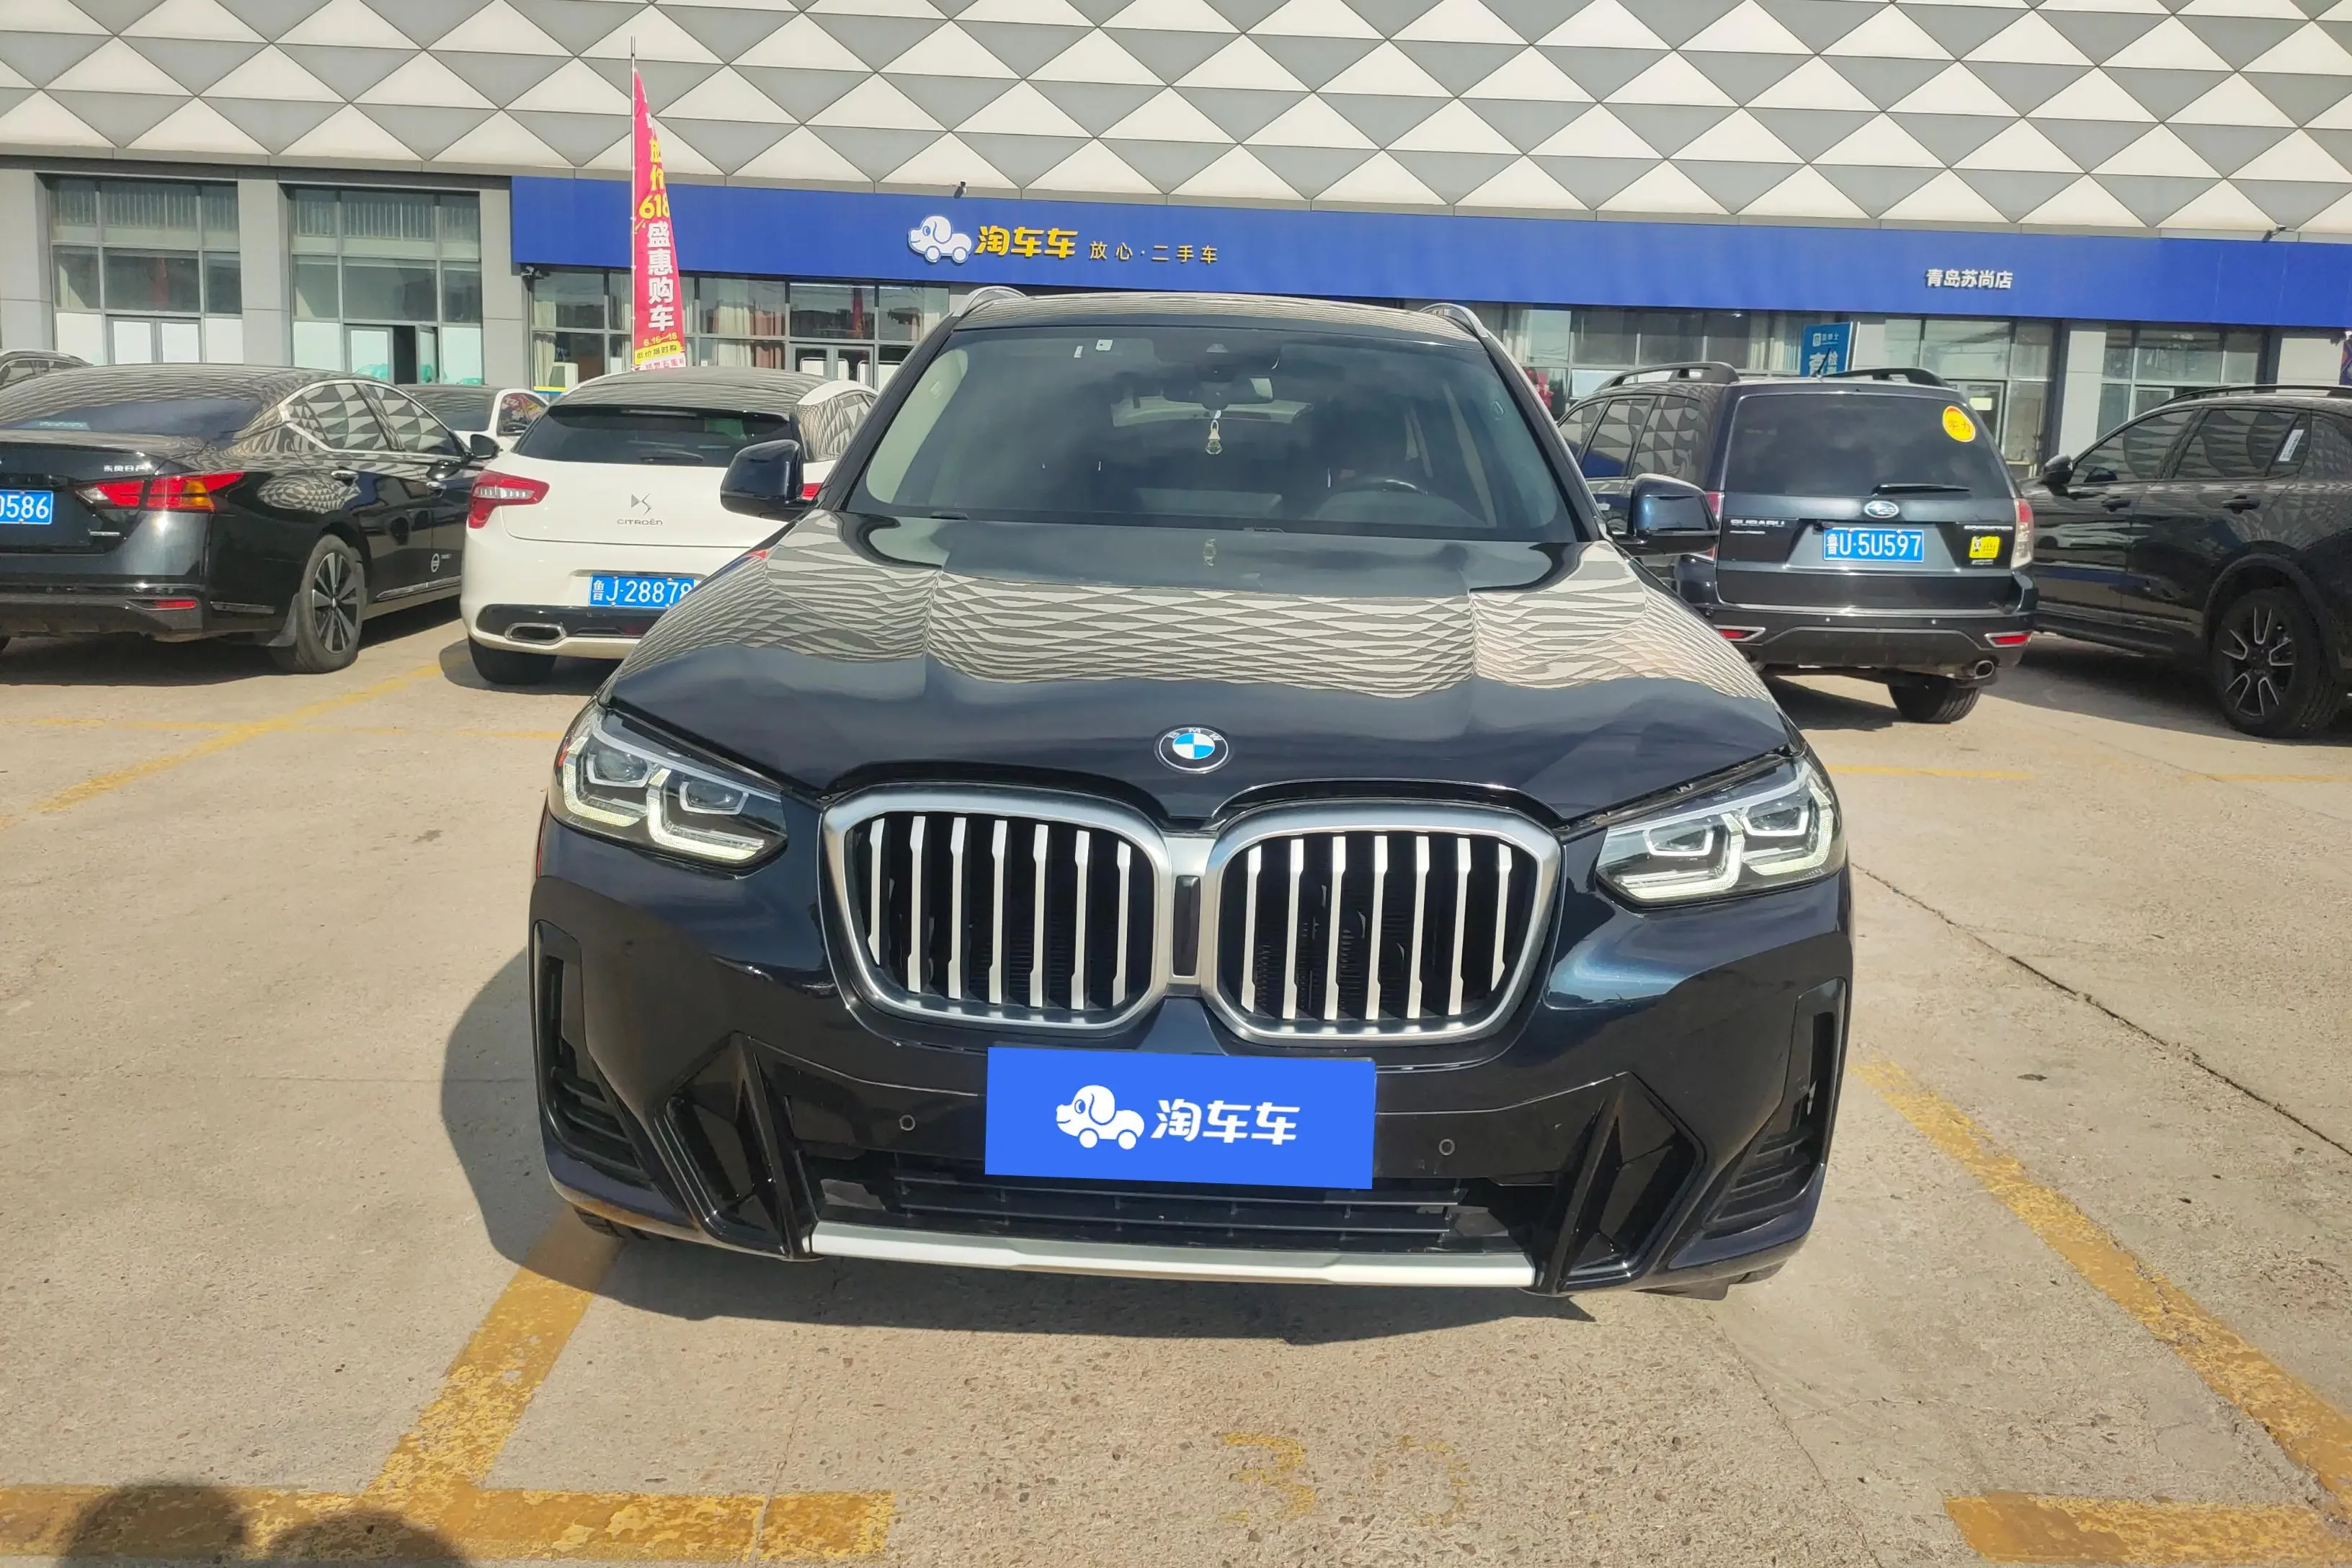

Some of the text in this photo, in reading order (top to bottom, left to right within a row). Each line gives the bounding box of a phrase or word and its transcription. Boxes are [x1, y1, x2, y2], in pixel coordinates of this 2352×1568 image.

[974, 226, 1079, 258] 淘车车
[647, 220, 674, 332] 盛惠购车
[1925, 269, 2013, 289] 青岛苏尚店
[1730, 519, 1785, 527] SUBARU
[1167, 727, 1223, 741] BMW
